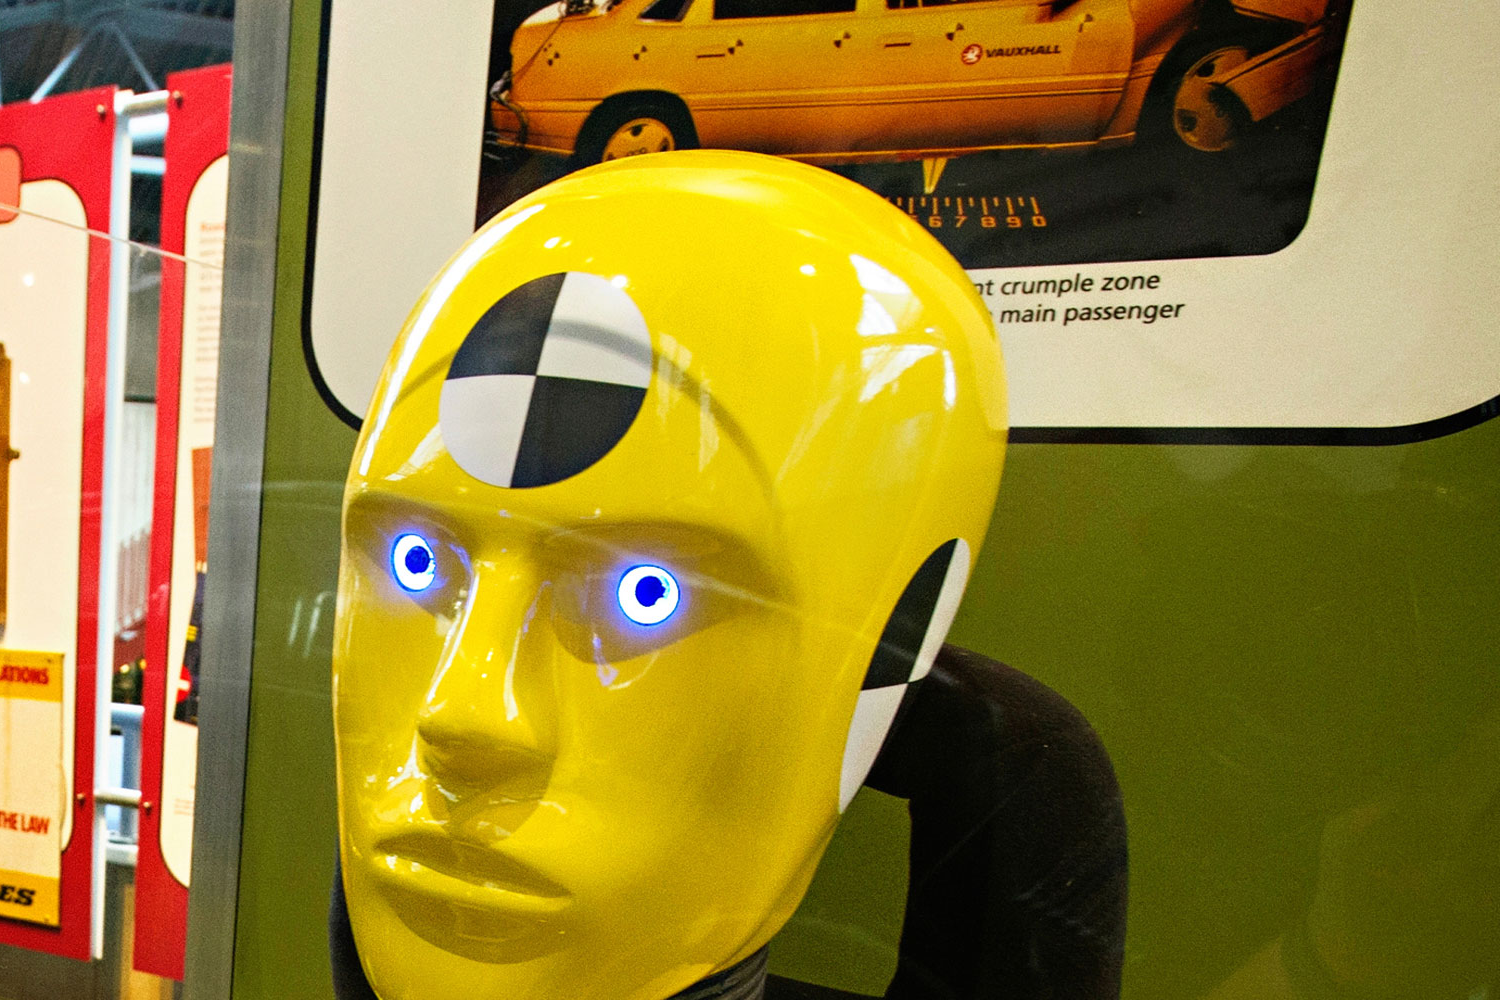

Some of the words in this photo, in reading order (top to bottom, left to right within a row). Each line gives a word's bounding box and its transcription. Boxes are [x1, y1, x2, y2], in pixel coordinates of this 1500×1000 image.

[986, 45, 1061, 58] VAUXHALL
[928, 216, 943, 228] 6
[955, 215, 967, 228] 7
[981, 216, 996, 228] 8
[1006, 216, 1023, 228] 9
[1000, 274, 1094, 298] crumple
[1101, 275, 1161, 291] zone
[1000, 304, 1056, 323] main
[1063, 303, 1185, 326] passenger
[21, 813, 50, 834] LAW
